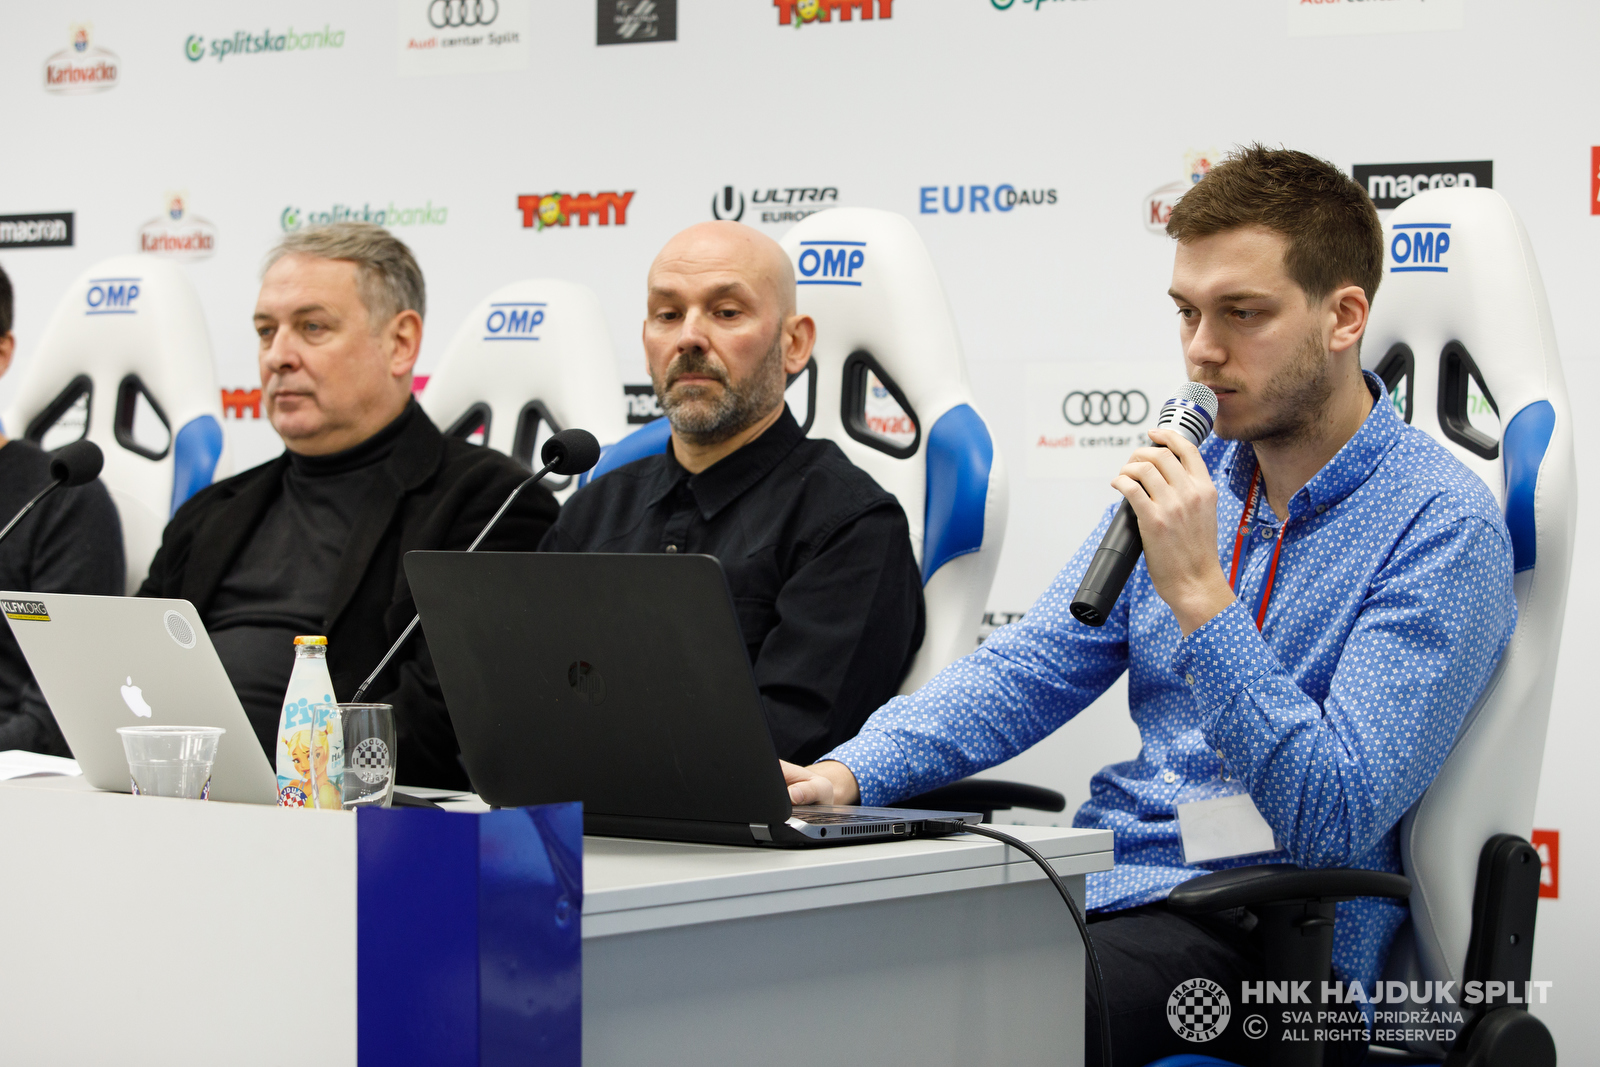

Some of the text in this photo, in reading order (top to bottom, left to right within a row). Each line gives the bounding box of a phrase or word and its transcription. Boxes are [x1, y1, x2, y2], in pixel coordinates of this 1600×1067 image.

[209, 23, 346, 63] splitskabanka
[407, 36, 438, 50] Audi
[487, 31, 520, 47] Split
[752, 186, 839, 205] ULTRA
[517, 190, 636, 228] TOMMY
[0, 219, 67, 242] macron
[1390, 231, 1450, 264] OMP
[798, 248, 865, 278] OMP
[86, 284, 140, 308] OMP
[486, 309, 545, 333] OMP
[1036, 433, 1075, 448] Audi
[1079, 434, 1132, 449] centar
[1244, 483, 1260, 524] HAJDUK
